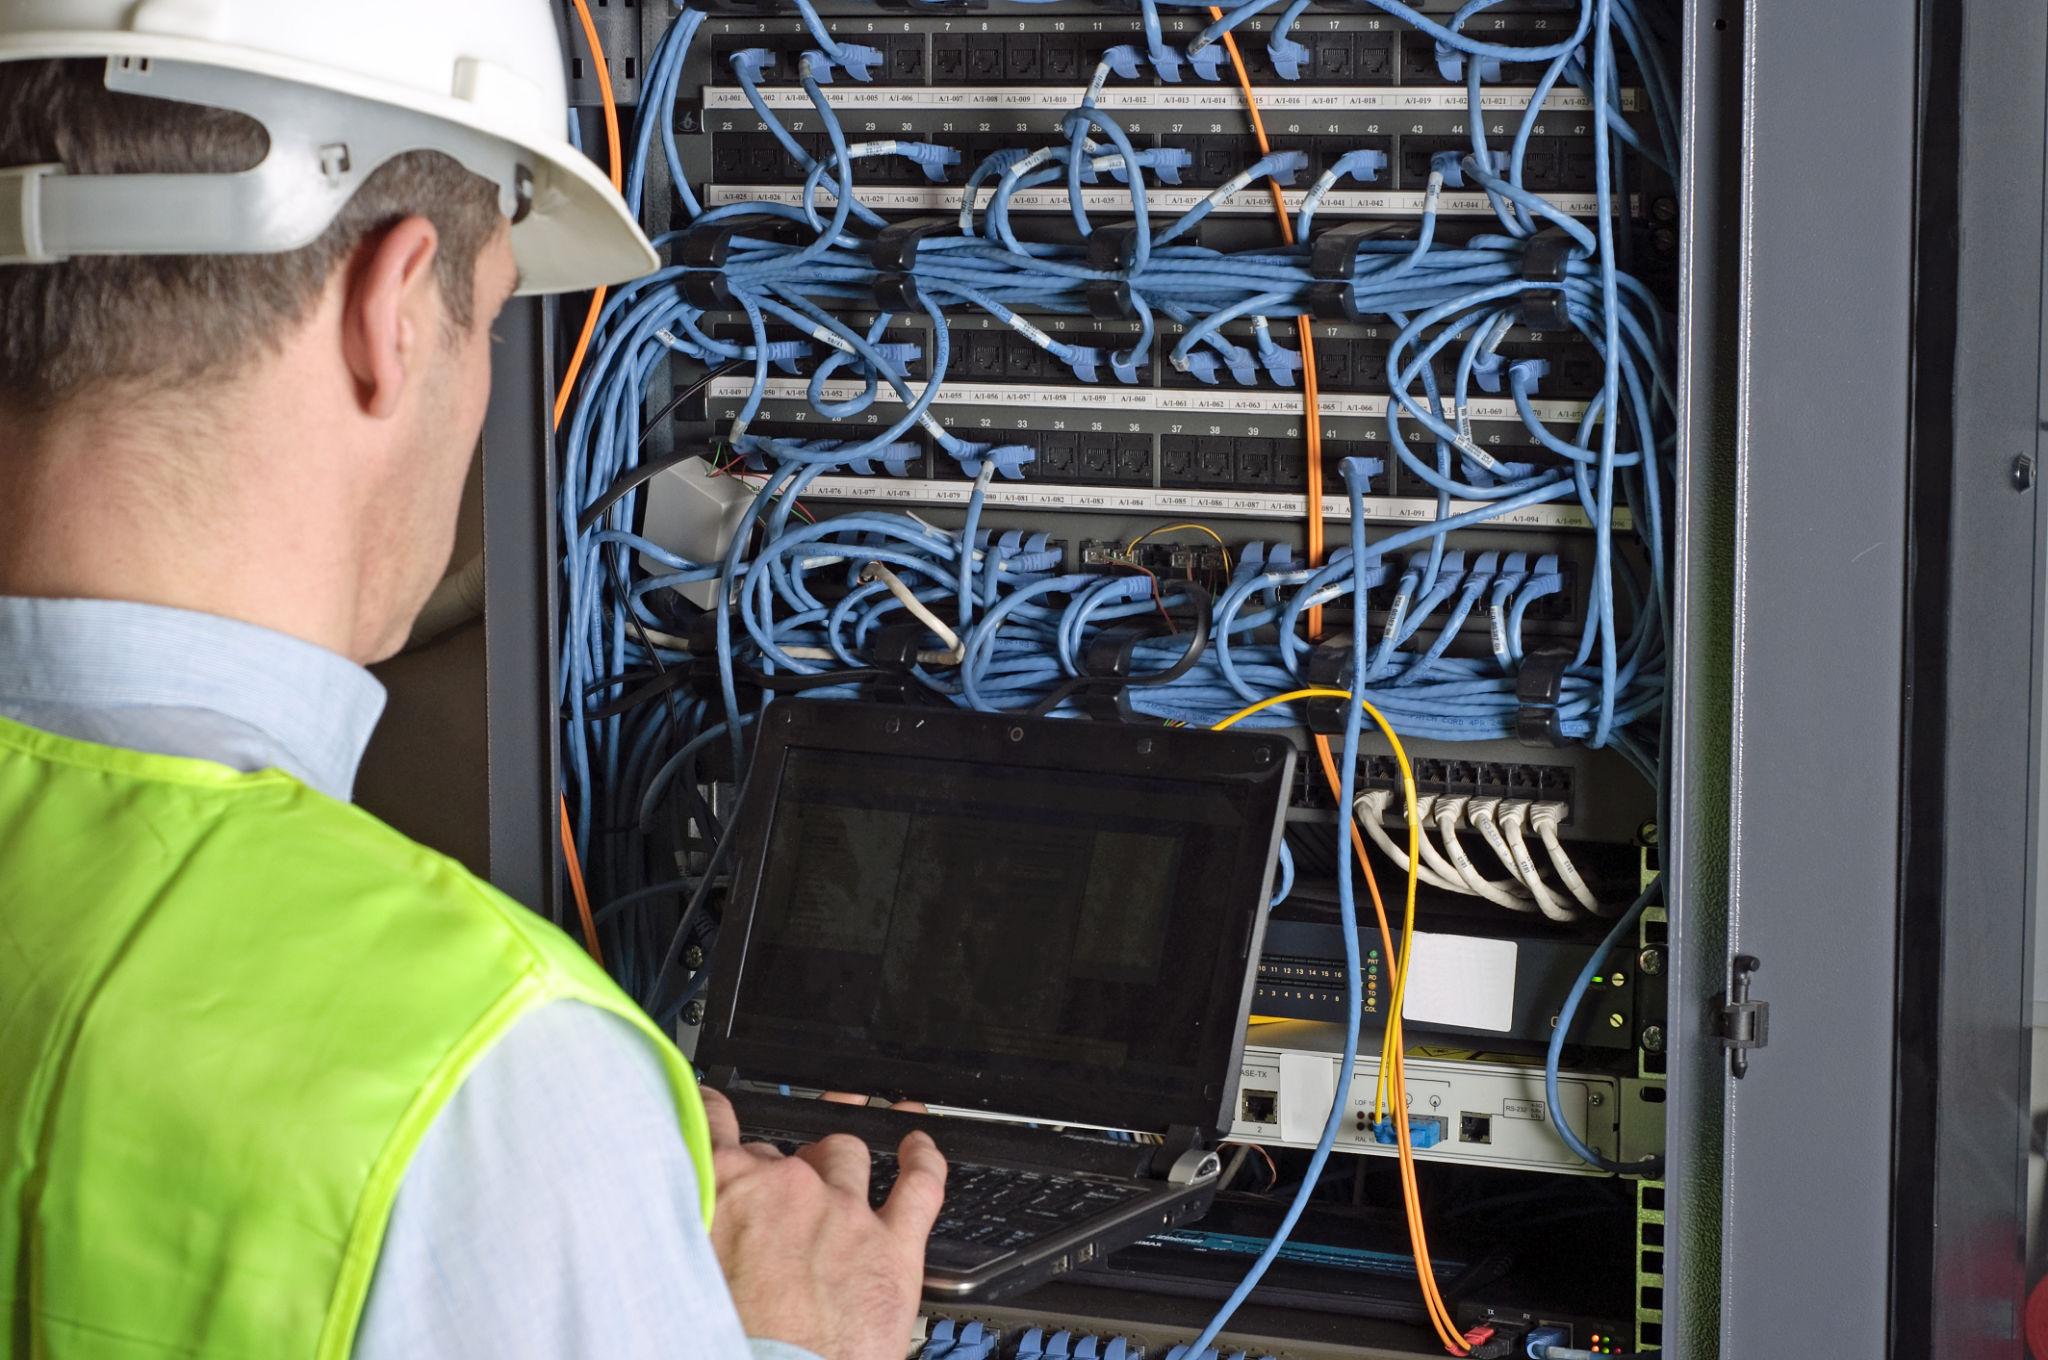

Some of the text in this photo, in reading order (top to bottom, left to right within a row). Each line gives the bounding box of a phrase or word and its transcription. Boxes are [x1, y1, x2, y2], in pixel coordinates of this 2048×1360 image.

[724, 24, 729, 32] 1
[759, 24, 765, 32] 2
[795, 24, 801, 32] 3
[867, 23, 873, 31] 5
[904, 23, 910, 31] 6
[945, 23, 951, 31] 7
[982, 23, 988, 31] 8
[1019, 22, 1025, 31] 9
[1054, 22, 1065, 31] 10
[1093, 22, 1102, 30] 11
[1131, 22, 1141, 30] 12
[1173, 21, 1184, 30] 13
[1251, 21, 1261, 30] 15
[1329, 21, 1340, 30] 17
[1369, 21, 1380, 30] 18
[1495, 20, 1505, 29] 21
[1536, 20, 1546, 28] 22
[722, 122, 732, 131] 25
[794, 122, 803, 131] 27
[866, 123, 875, 131] 29
[902, 123, 912, 131] 30
[943, 123, 953, 131] 31
[979, 123, 990, 131] 32
[1016, 123, 1027, 131] 33
[1129, 123, 1140, 132] 36
[1172, 124, 1183, 133] 37
[1210, 124, 1222, 133] 38
[1288, 124, 1299, 133] 40
[1328, 124, 1339, 133] 41
[1367, 124, 1378, 133] 42
[1411, 125, 1423, 134] 43
[1452, 125, 1463, 134] 44
[1492, 125, 1504, 134] 45
[1533, 126, 1544, 134] 46
[1574, 126, 1585, 134] 47
[728, 314, 732, 322] 1
[905, 318, 911, 326] 6
[946, 319, 951, 327] 7
[982, 320, 988, 328] 8
[1054, 321, 1065, 330] 10
[1092, 322, 1102, 330] 11
[1130, 323, 1140, 332] 12
[1172, 324, 1183, 333] 13
[1327, 327, 1338, 336] 17
[1366, 328, 1377, 337] 18
[1531, 333, 1543, 341] 22
[725, 410, 735, 419] 25
[760, 411, 771, 420] 26
[796, 412, 806, 421] 27
[867, 415, 878, 423] 29
[944, 417, 954, 425] 31
[980, 418, 991, 427] 32
[1017, 420, 1028, 428] 33
[1054, 421, 1065, 429] 34
[1092, 422, 1102, 431] 35
[1129, 423, 1140, 432] 36
[1171, 424, 1182, 433] 37
[1209, 426, 1221, 434] 38
[1247, 427, 1259, 436] 39
[1286, 428, 1298, 437] 40
[1326, 429, 1337, 438] 41
[1364, 431, 1376, 440] 42
[1409, 433, 1420, 441] 43
[1488, 435, 1500, 444] 45
